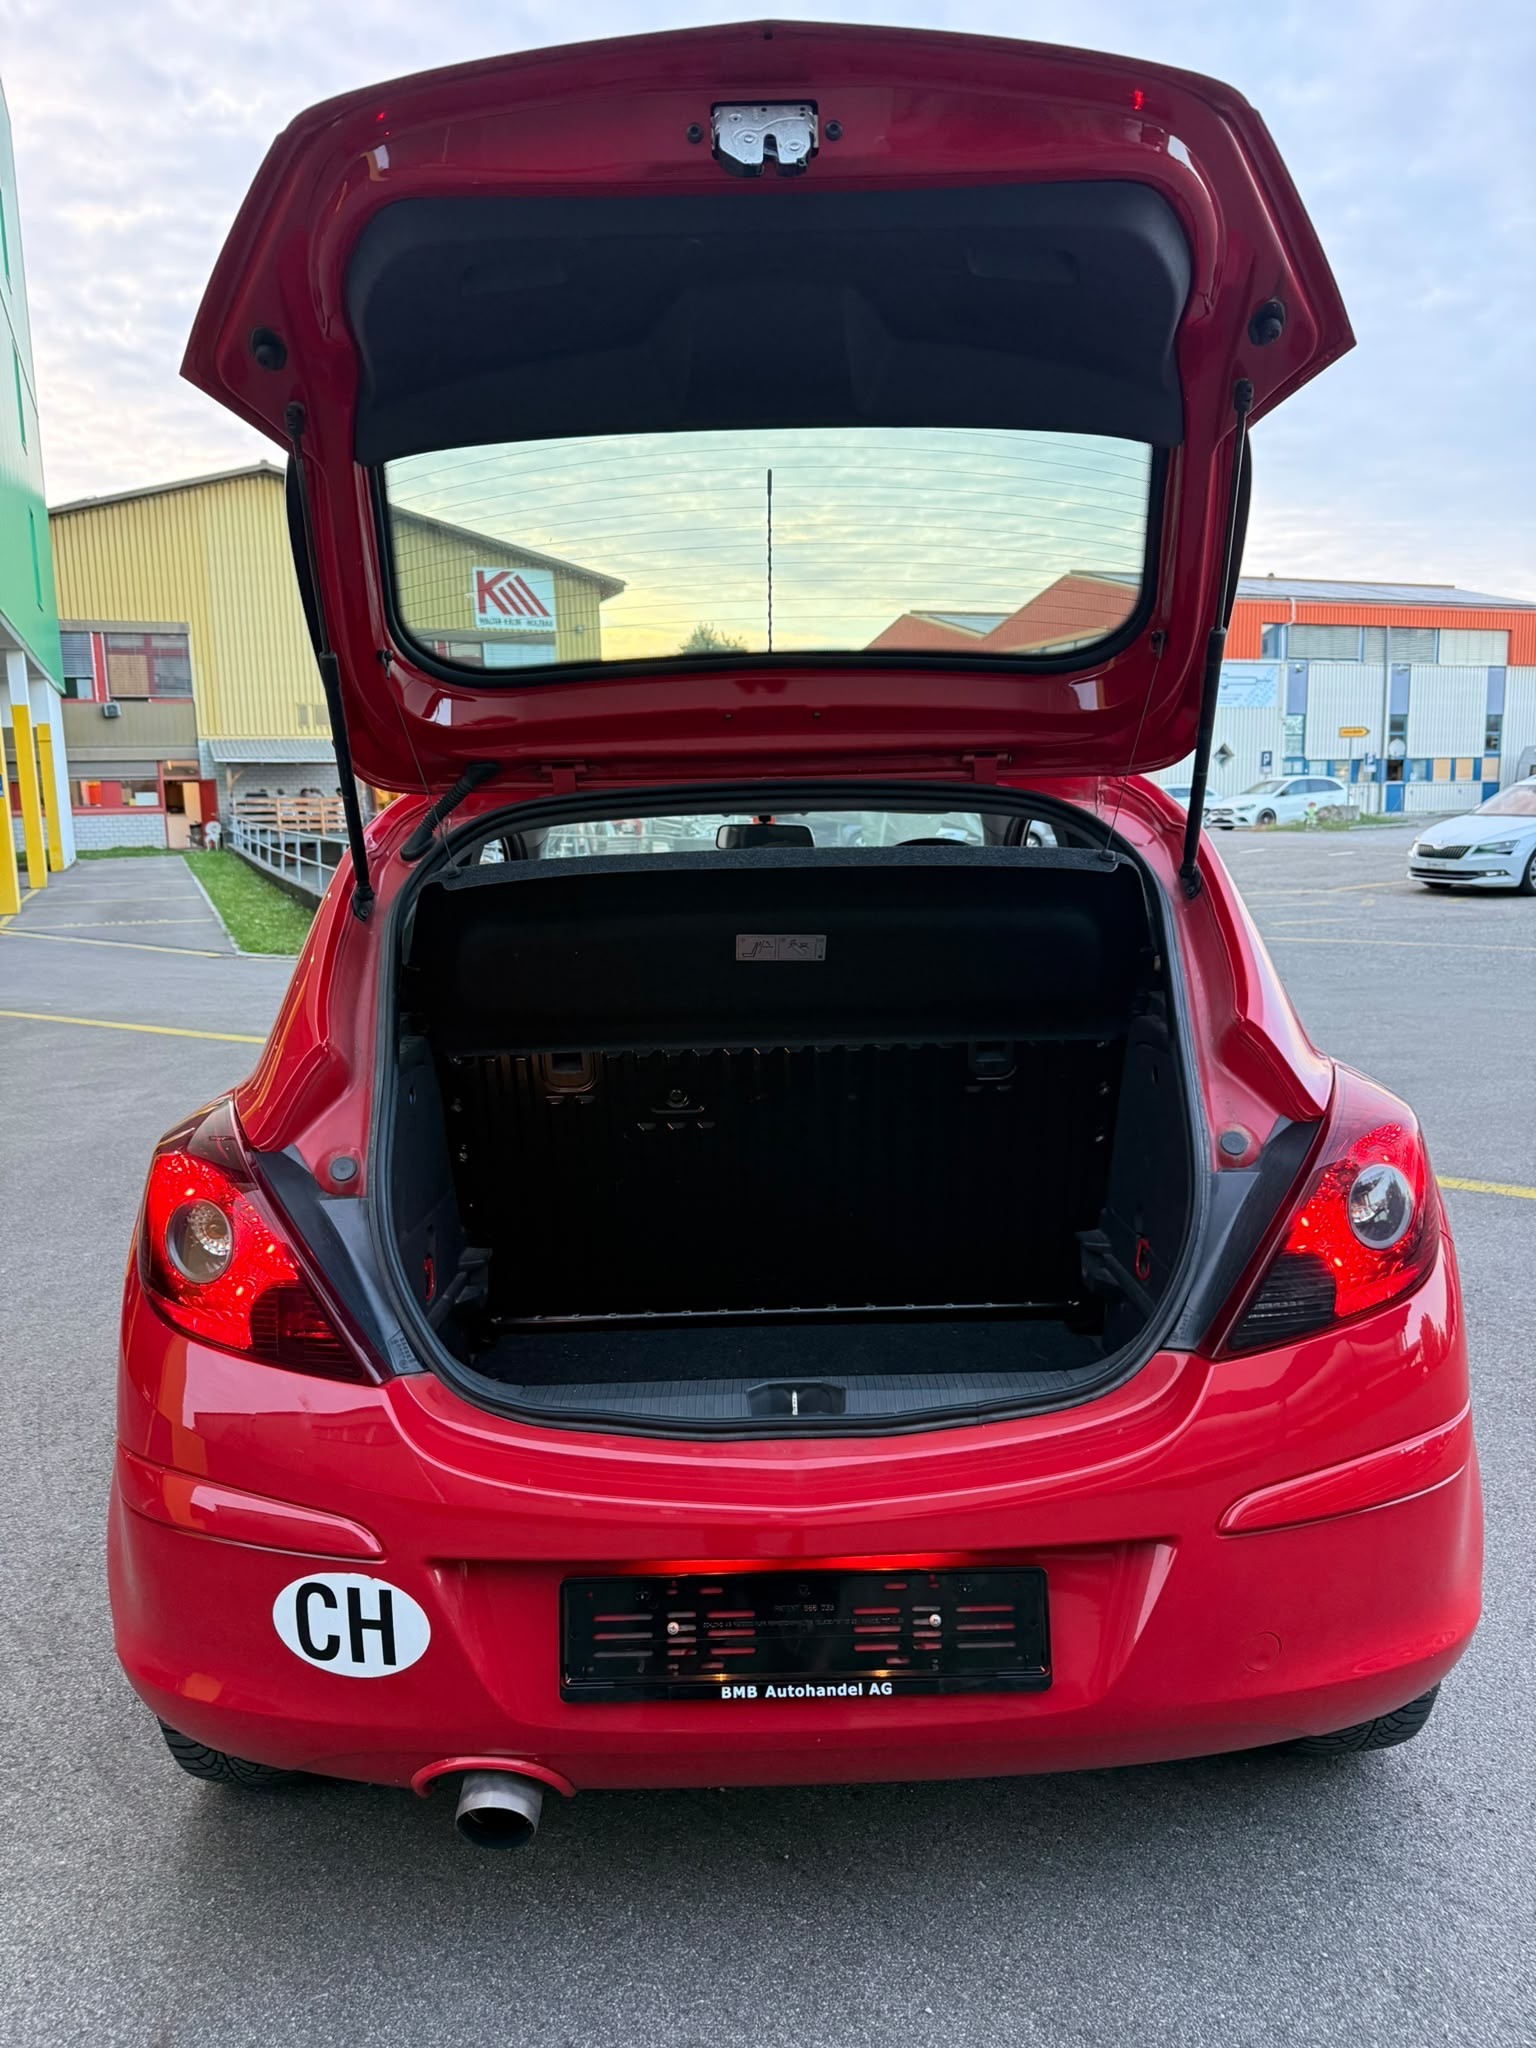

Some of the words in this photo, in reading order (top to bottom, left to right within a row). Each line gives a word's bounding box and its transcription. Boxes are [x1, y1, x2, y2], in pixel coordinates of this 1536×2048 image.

[1263, 753, 1270, 765] P
[296, 1582, 396, 1666] CH
[721, 1686, 758, 1699] BMB
[765, 1683, 863, 1698] Autohandel
[869, 1682, 893, 1695] AG
